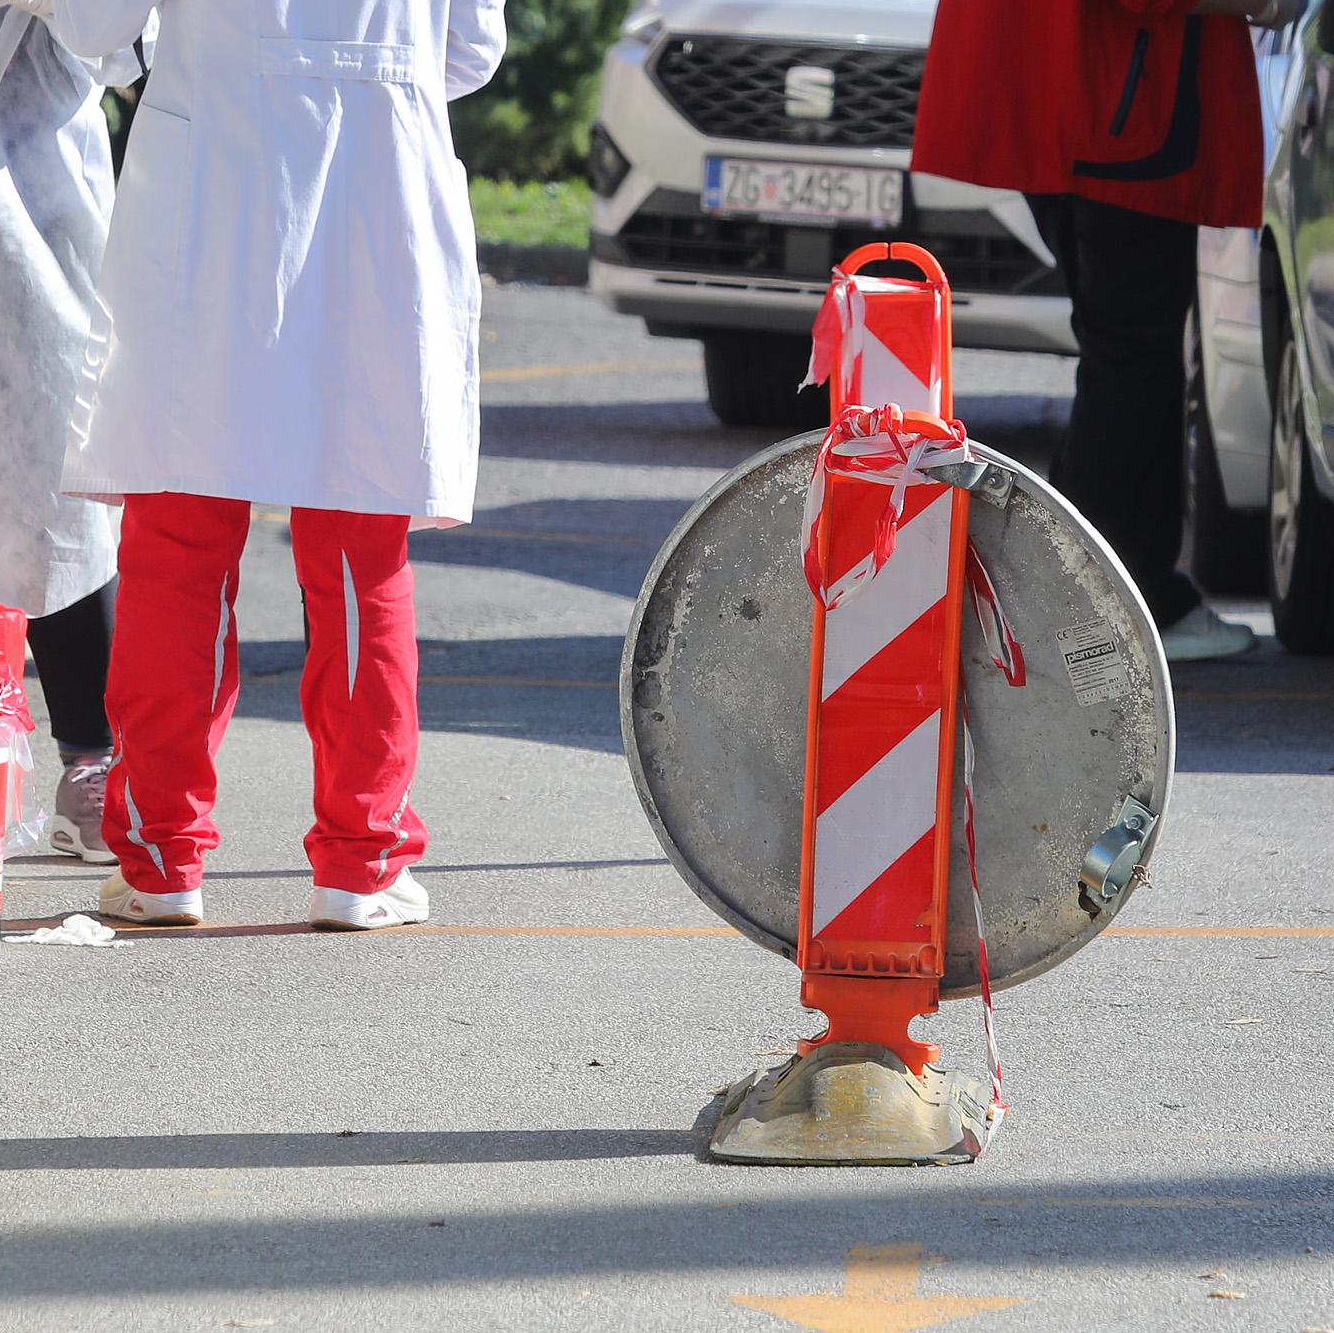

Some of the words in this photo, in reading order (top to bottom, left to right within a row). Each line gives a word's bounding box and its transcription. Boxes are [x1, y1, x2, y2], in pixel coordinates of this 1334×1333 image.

[726, 165, 762, 205] ZG
[778, 168, 896, 214] 3495-IG
[1066, 641, 1116, 665] pismorad
